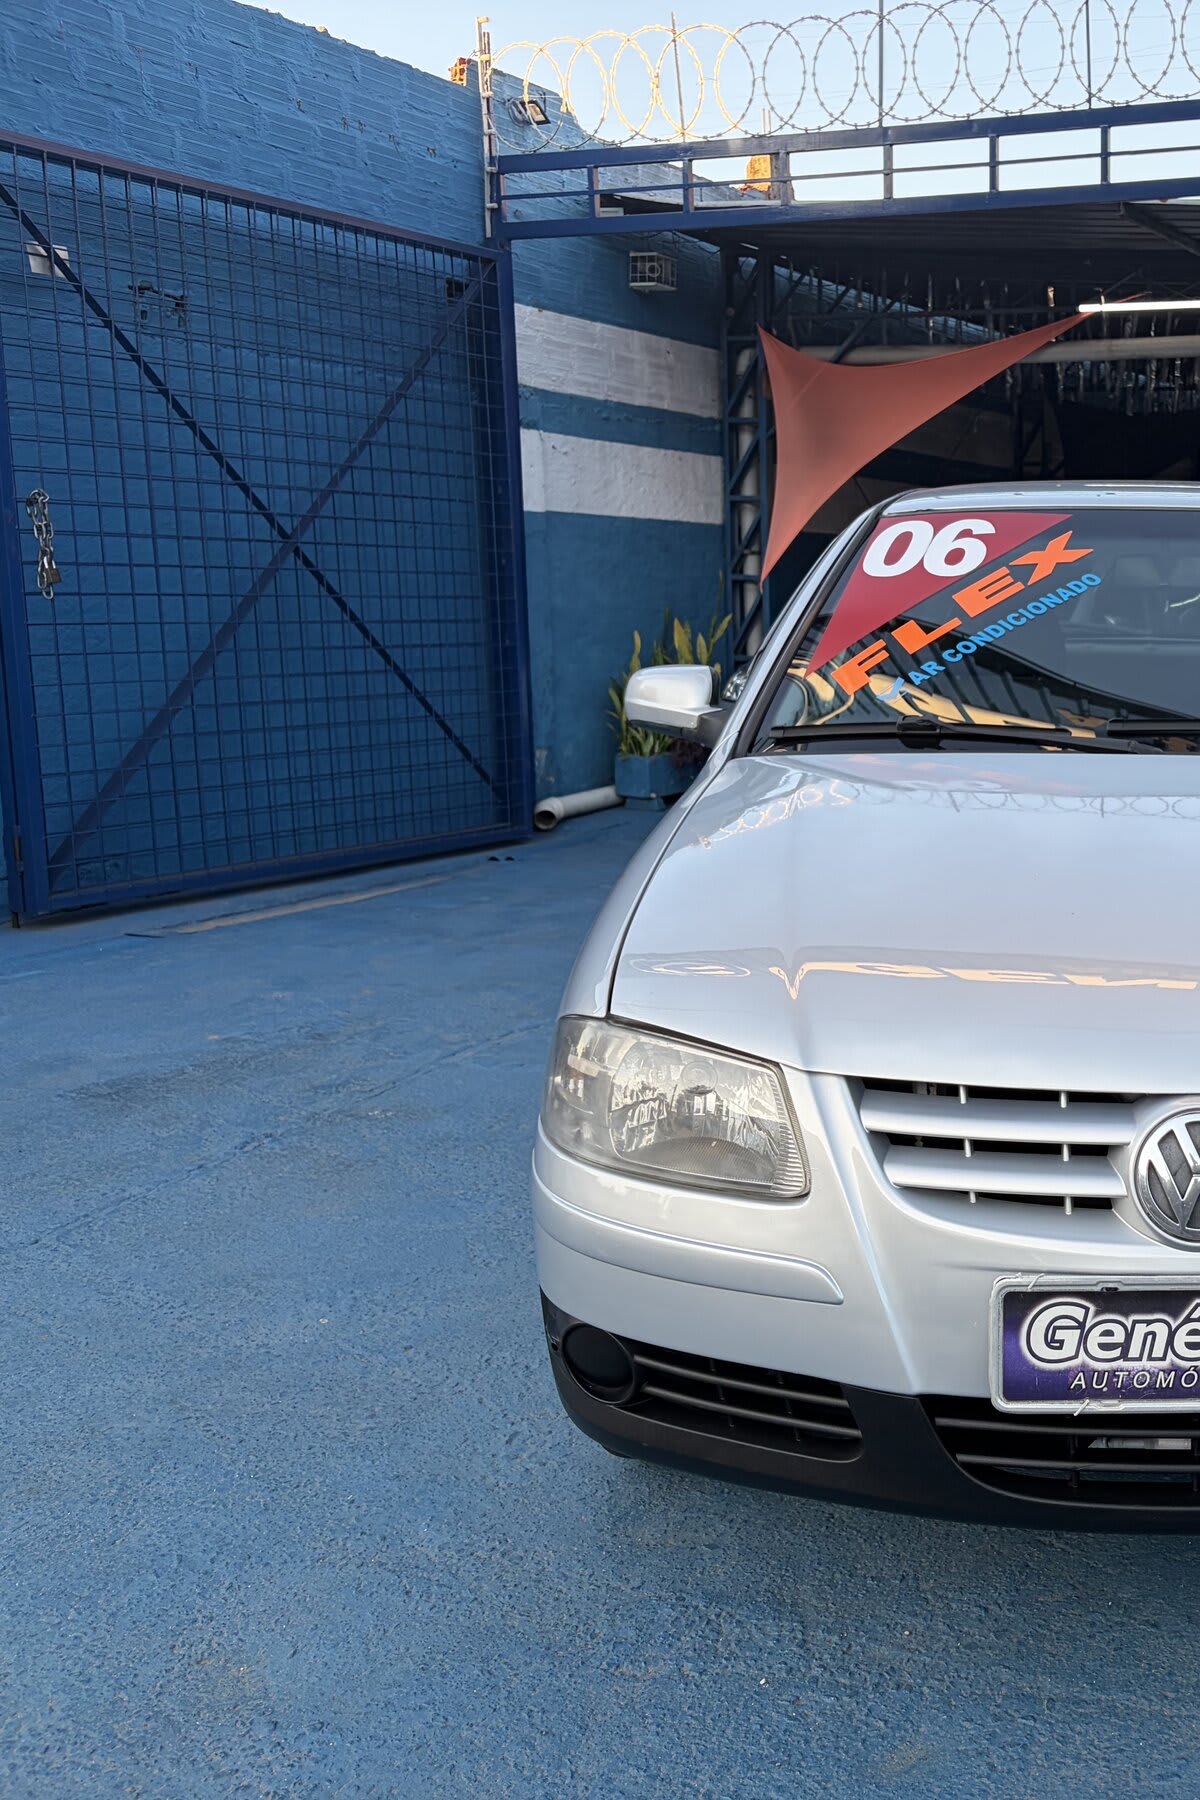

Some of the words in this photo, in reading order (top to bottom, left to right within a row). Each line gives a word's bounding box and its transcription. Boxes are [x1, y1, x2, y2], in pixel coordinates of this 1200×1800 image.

[862, 518, 996, 577] 06
[831, 530, 1094, 695] FLEX
[908, 660, 945, 686] AR
[942, 572, 1102, 663] CONDICIONADO
